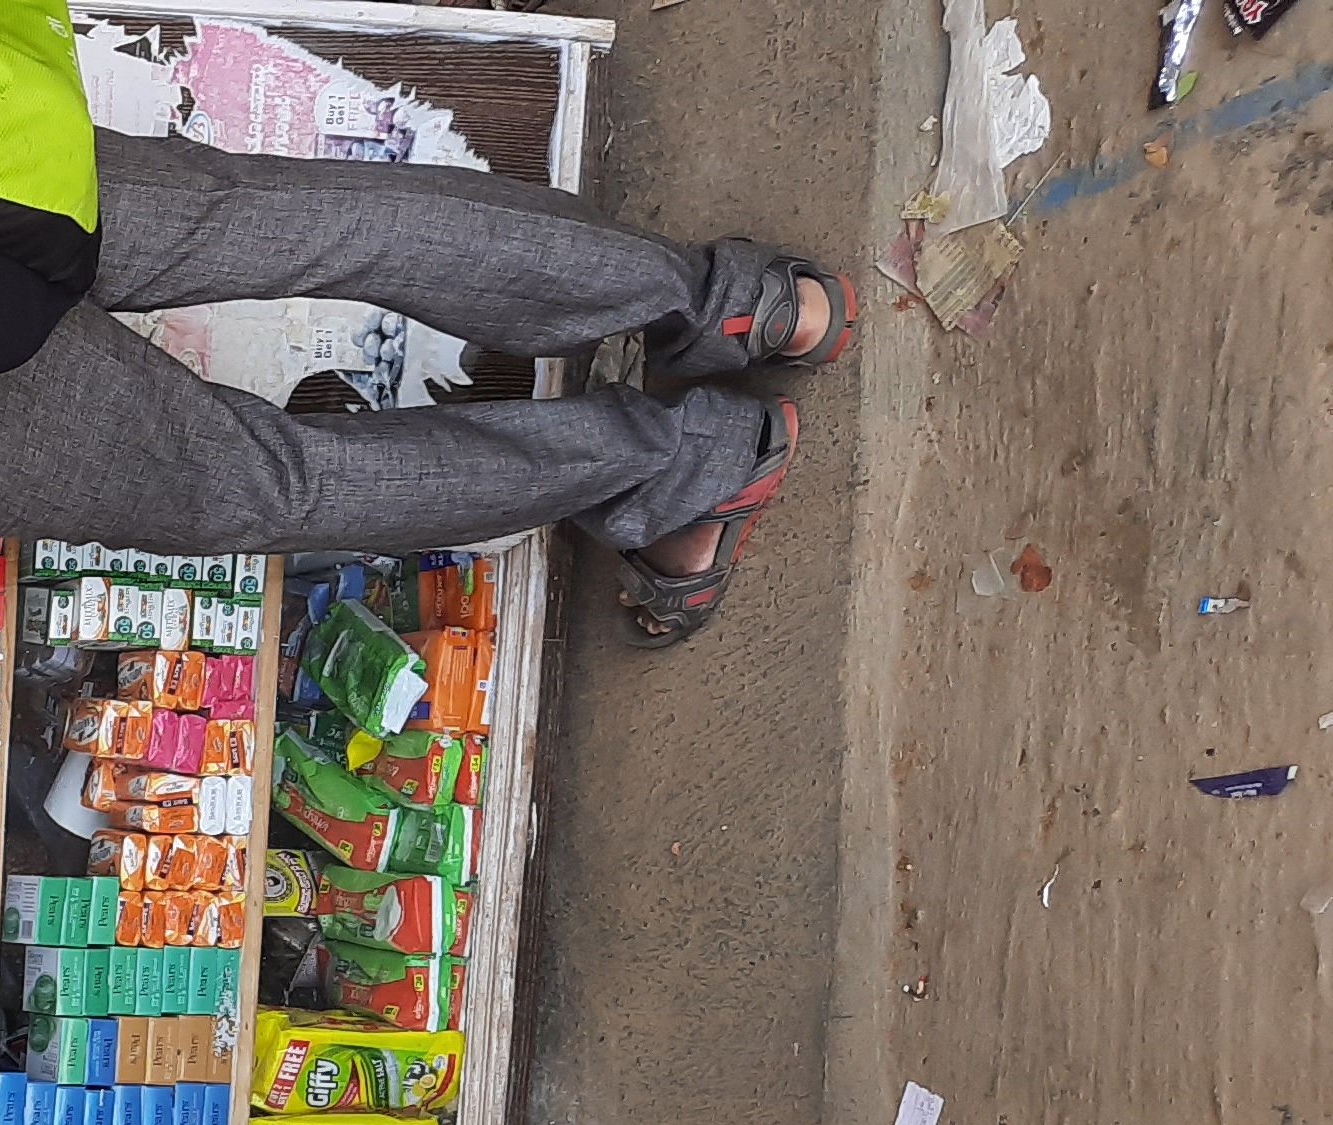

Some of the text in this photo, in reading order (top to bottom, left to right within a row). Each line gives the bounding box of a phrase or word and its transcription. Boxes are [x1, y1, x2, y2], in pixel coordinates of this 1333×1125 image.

[325, 104, 336, 125] Buy
[336, 104, 345, 125] Get
[97, 896, 109, 927] Pears
[59, 966, 71, 997] Pears
[112, 964, 123, 994] Pears
[139, 966, 150, 996] Pears
[165, 963, 176, 994] Pears
[197, 966, 209, 997] Pears
[67, 1038, 79, 1067] Pears
[153, 1036, 164, 1066] Pears
[279, 1045, 308, 1080] FREE
[305, 1058, 339, 1107] Giffy
[372, 1059, 383, 1078] SALT
[3, 1092, 15, 1122] Pears
